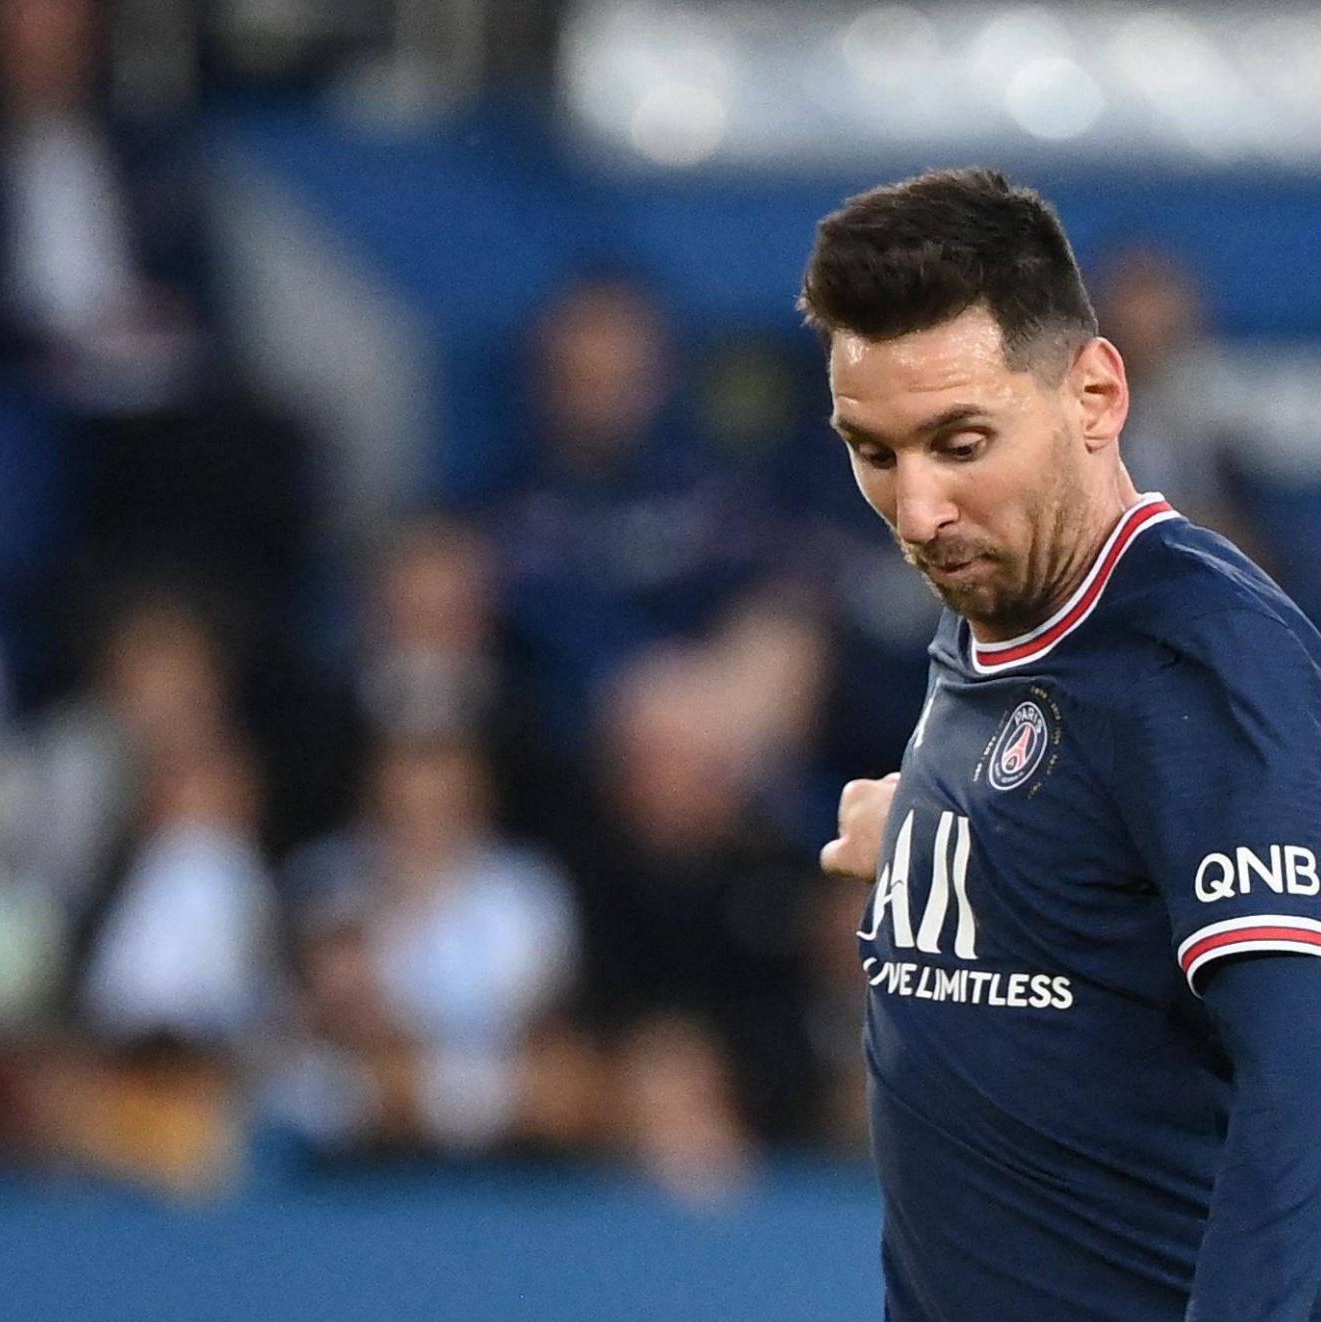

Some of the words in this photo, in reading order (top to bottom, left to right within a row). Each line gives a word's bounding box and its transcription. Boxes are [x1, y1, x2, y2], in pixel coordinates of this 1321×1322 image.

[1014, 706, 1043, 733] PARIS
[1195, 844, 1320, 903] QNB
[915, 966, 1074, 1009] LIMITLESS
